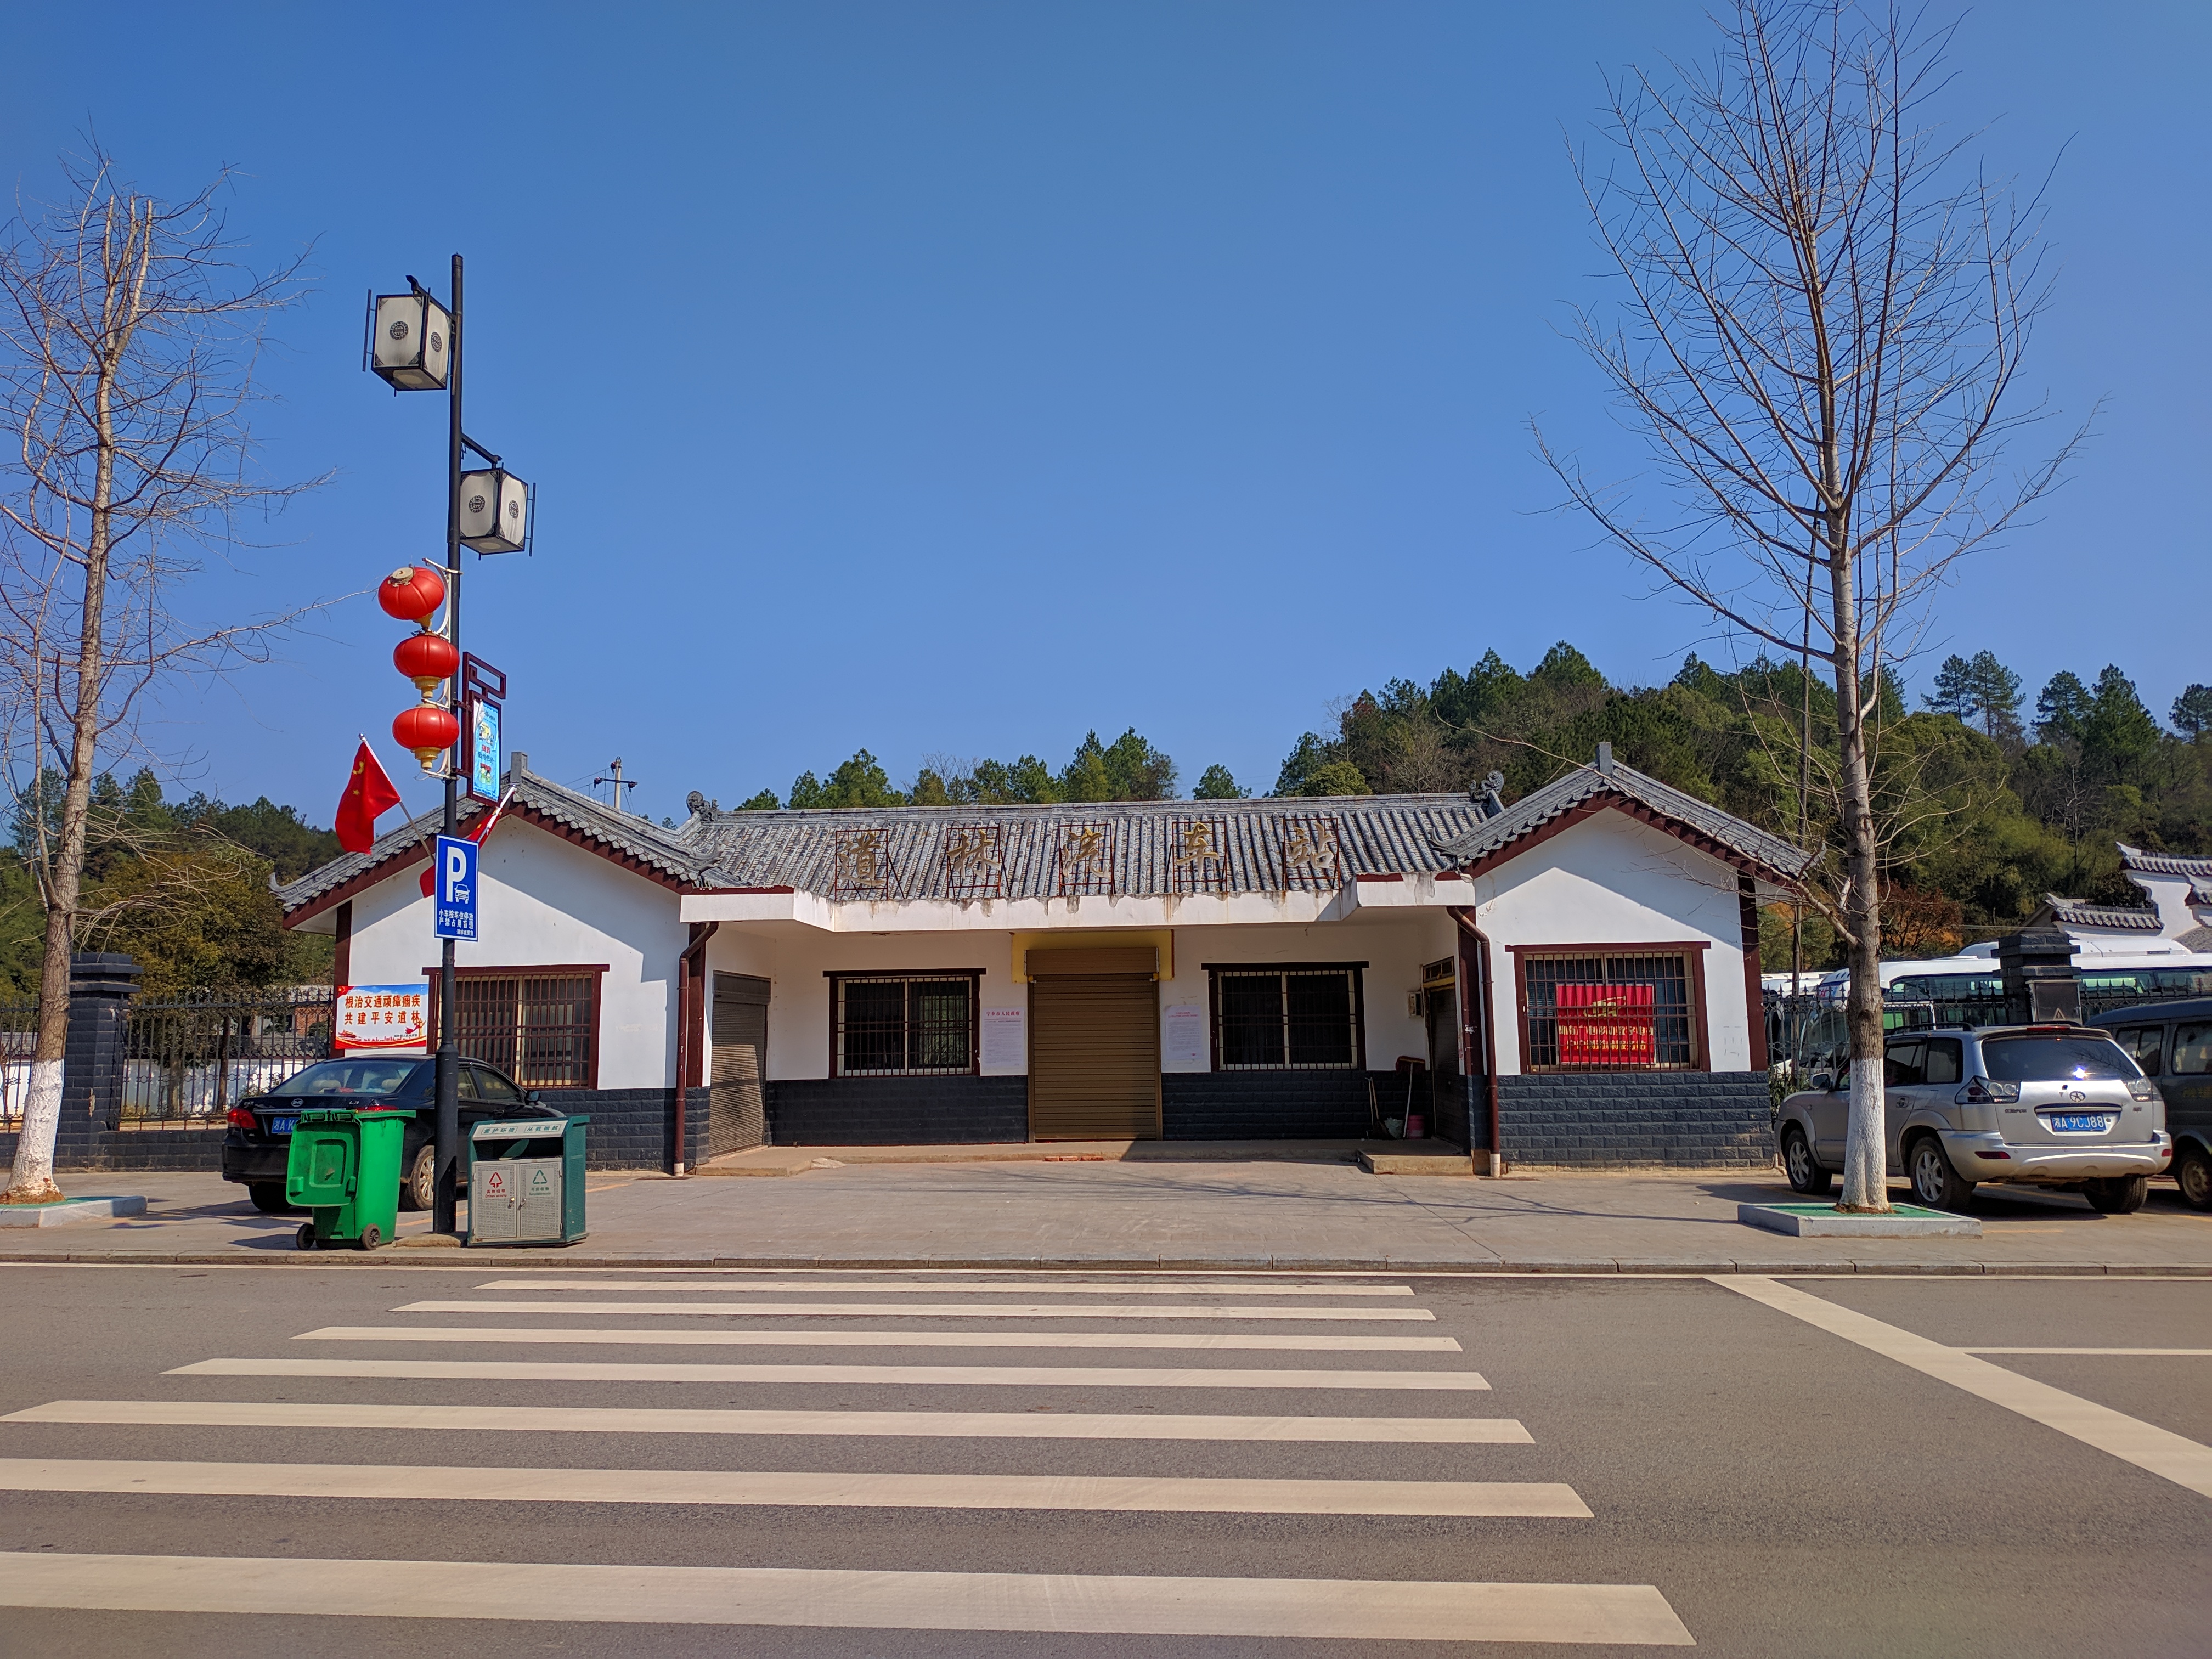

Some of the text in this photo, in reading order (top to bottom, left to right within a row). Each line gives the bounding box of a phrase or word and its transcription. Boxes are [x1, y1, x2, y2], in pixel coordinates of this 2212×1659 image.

[446, 846, 467, 902] P
[345, 994, 421, 1009] 根治交通顽瘴痼疾
[344, 1010, 420, 1025] 共建平安道林
